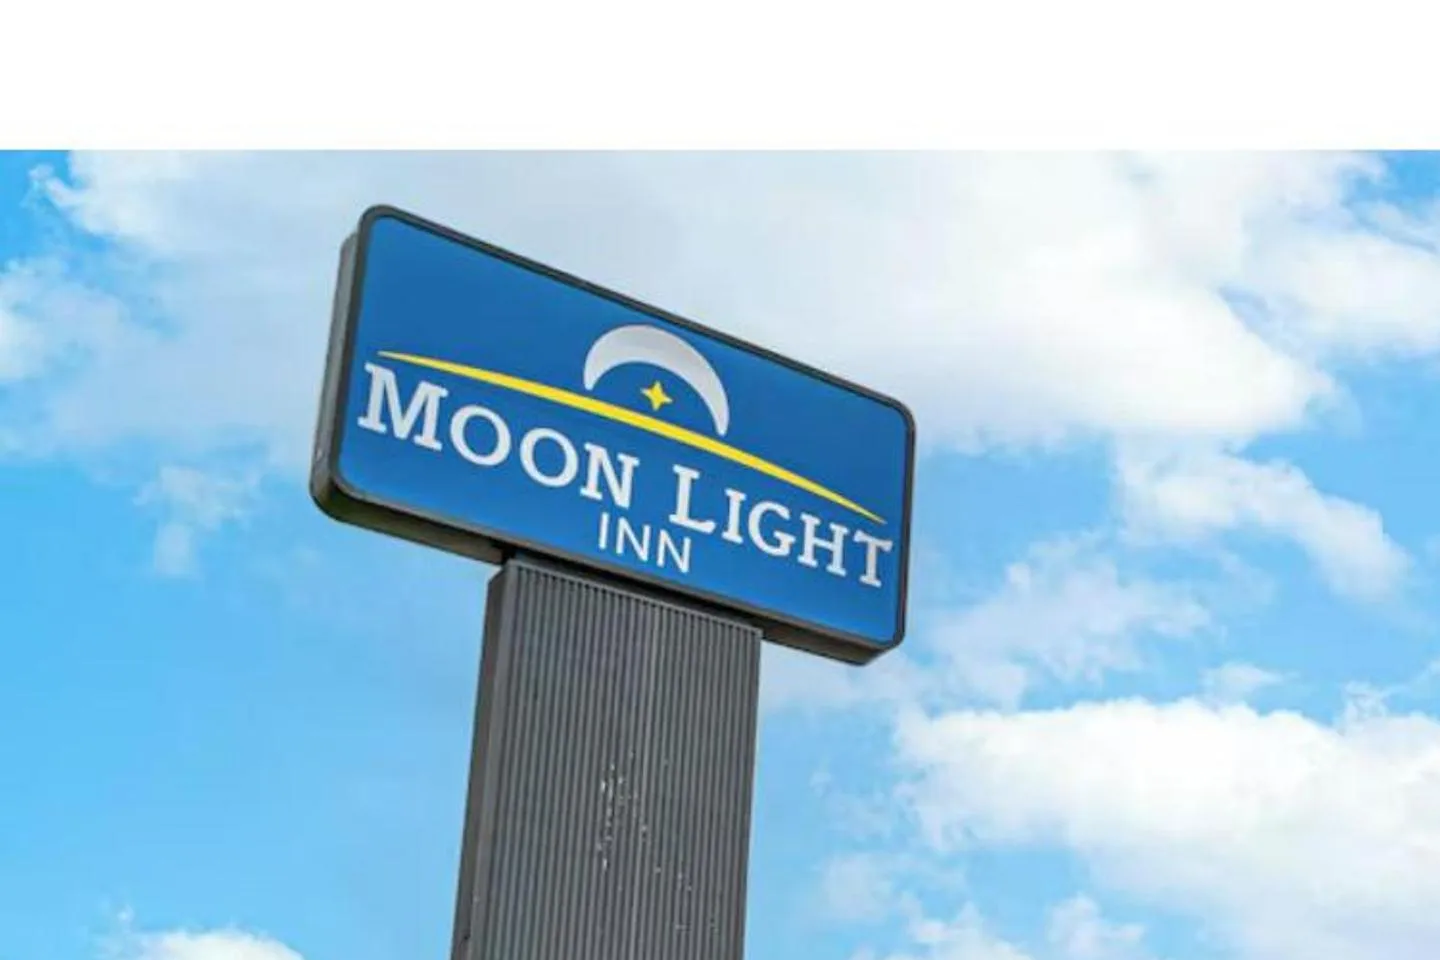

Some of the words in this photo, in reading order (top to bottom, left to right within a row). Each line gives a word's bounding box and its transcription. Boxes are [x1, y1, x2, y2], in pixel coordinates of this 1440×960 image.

[357, 362, 640, 509] MOON
[668, 464, 893, 588] LIGHT
[598, 512, 692, 573] INN
